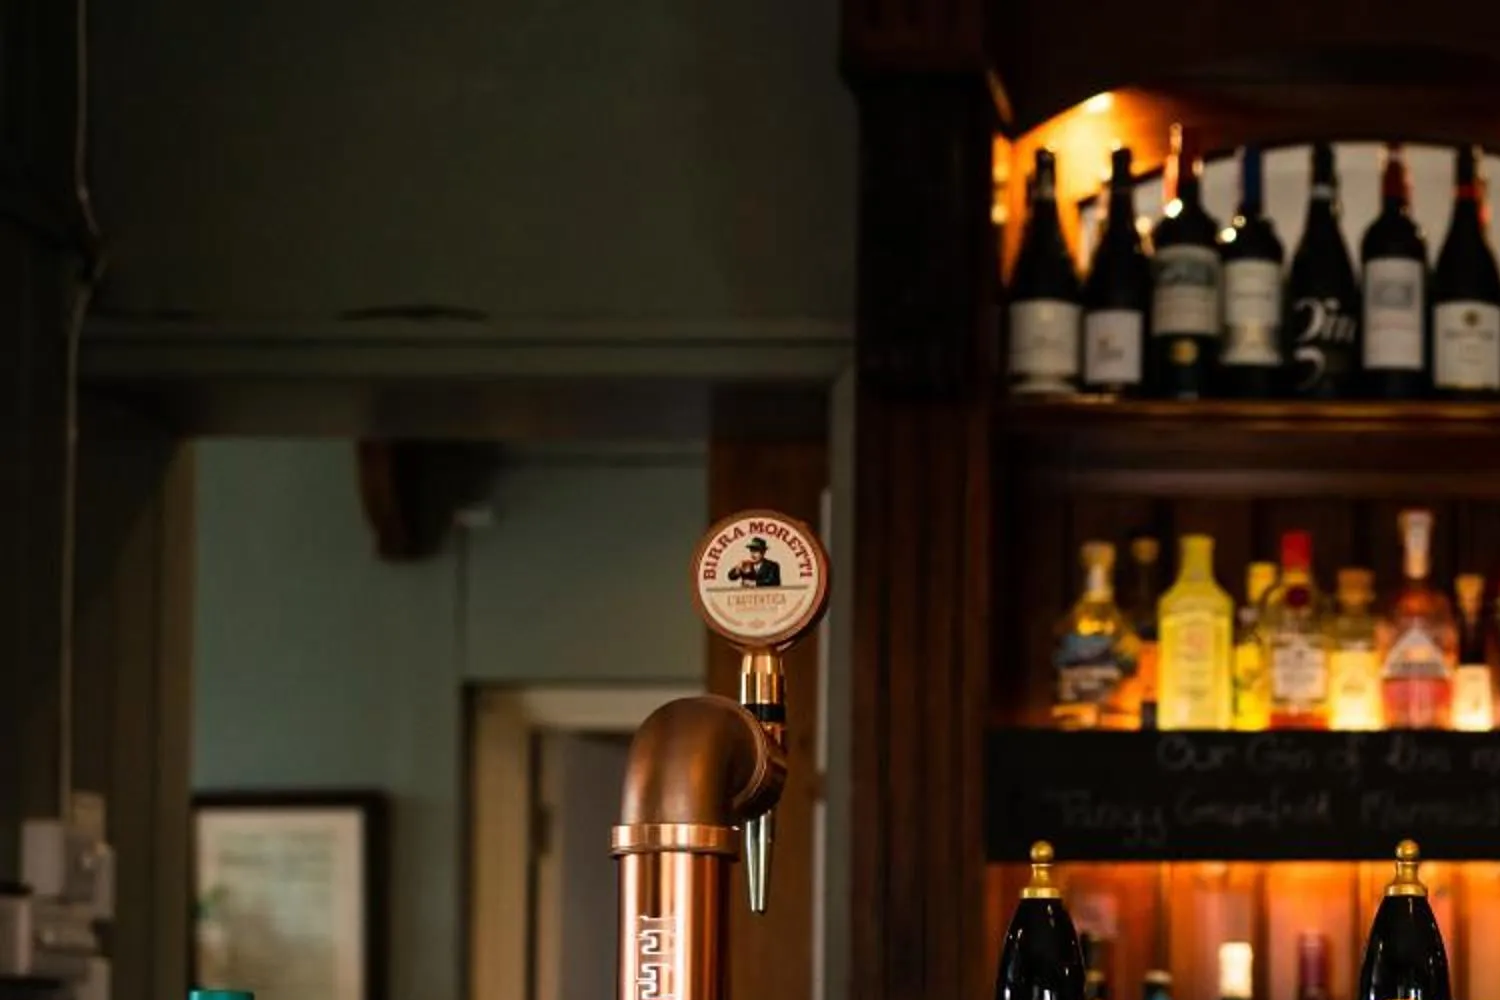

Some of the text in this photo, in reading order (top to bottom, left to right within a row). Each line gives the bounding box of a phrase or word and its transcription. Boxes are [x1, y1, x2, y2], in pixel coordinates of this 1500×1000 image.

[703, 521, 813, 581] BIRRA MORETTI
[1155, 734, 1236, 772] Our
